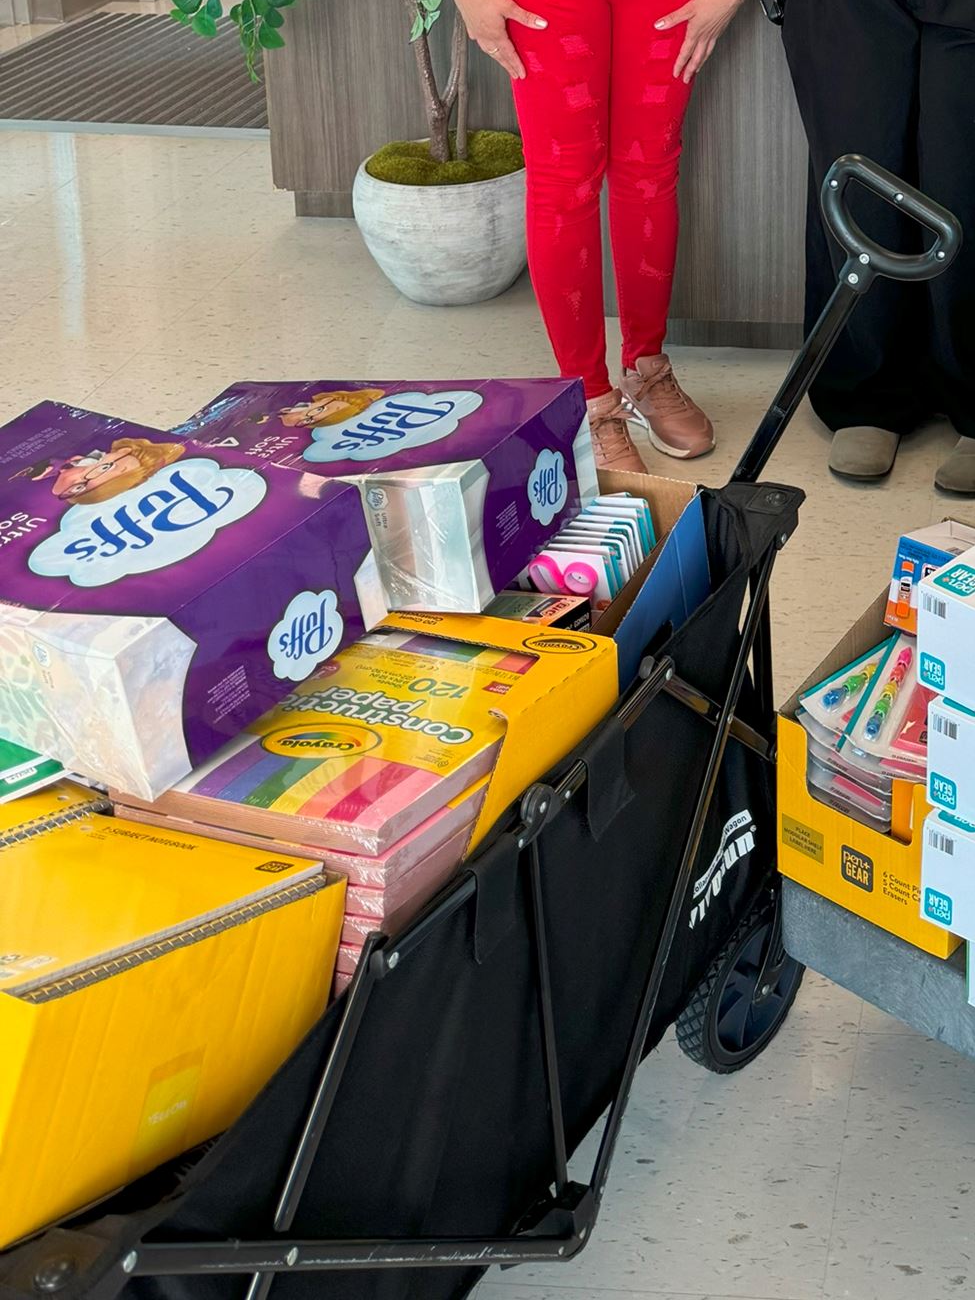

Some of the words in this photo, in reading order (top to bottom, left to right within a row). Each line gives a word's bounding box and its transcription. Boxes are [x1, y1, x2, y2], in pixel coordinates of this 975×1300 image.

[332, 399, 456, 453] Puffs
[533, 459, 563, 506] Puffs
[63, 470, 235, 561] Puffs
[0, 516, 48, 548] Ultr
[278, 598, 334, 664] Puffs
[923, 658, 942, 676] GEAR
[407, 677, 470, 699] 120
[315, 685, 426, 714] paper
[277, 737, 356, 751] Crayola
[933, 777, 953, 795] GEAR
[724, 815, 747, 836] Wagon
[845, 863, 869, 886] GEAR
[889, 873, 911, 889] Count
[882, 888, 908, 905] Erasers
[889, 882, 911, 899] Count
[929, 893, 949, 910] GEAR
